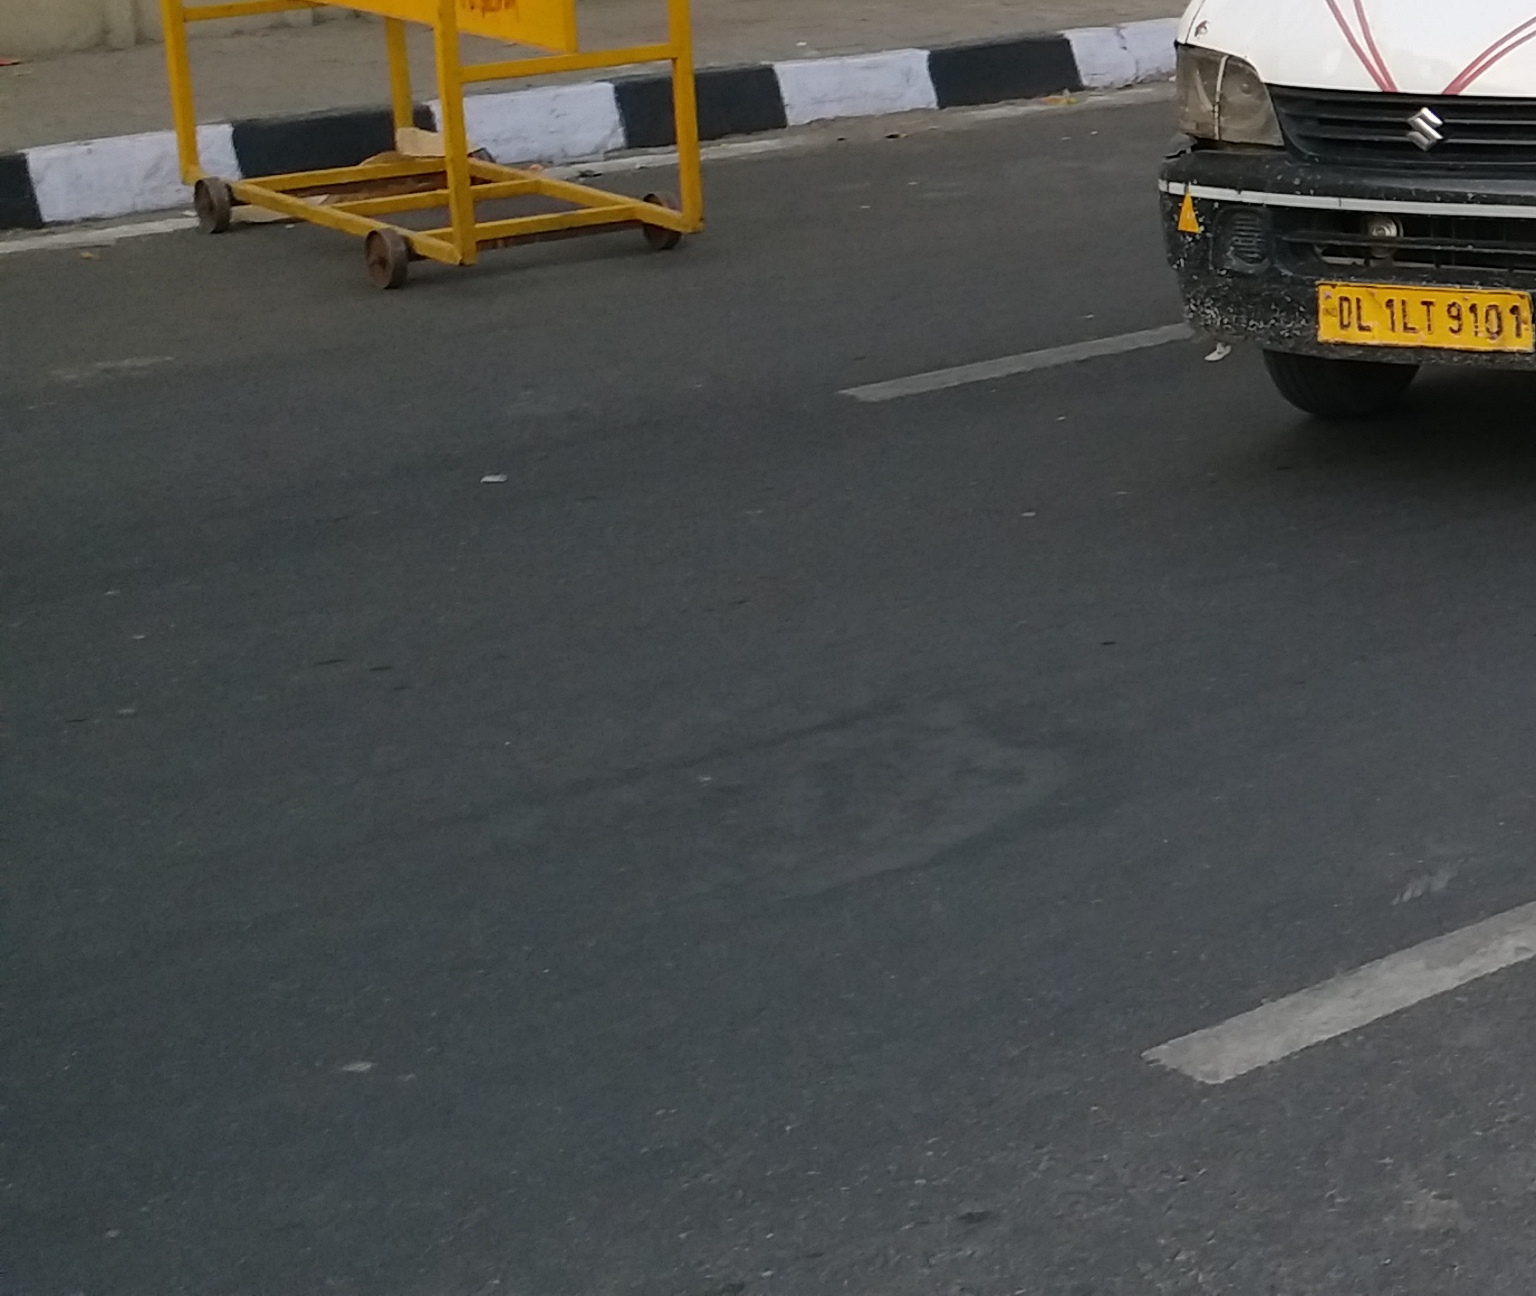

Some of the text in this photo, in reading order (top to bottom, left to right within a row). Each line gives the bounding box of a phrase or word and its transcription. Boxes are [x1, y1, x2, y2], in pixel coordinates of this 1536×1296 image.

[1338, 294, 1523, 339] DL 1LT 9101
